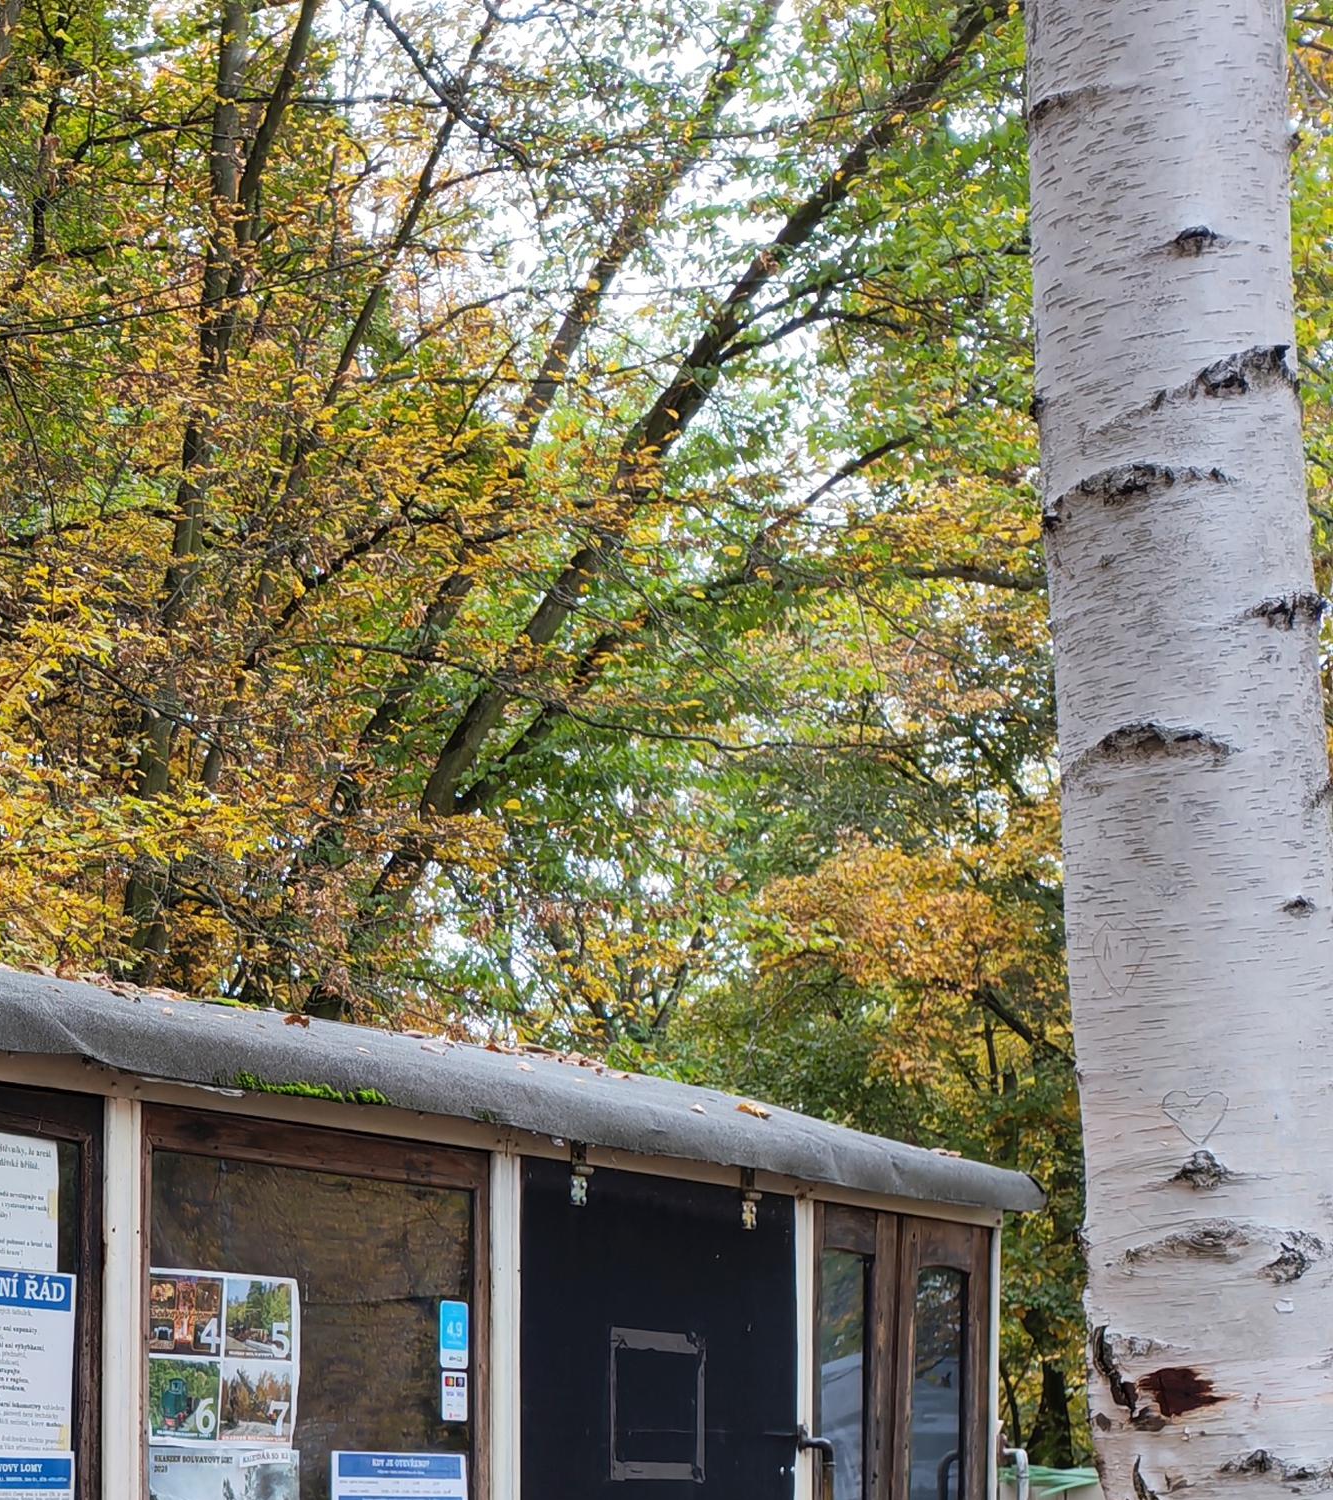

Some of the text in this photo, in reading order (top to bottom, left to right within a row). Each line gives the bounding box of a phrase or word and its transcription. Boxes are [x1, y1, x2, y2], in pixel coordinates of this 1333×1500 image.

[24, 1274, 66, 1302] ŘÁD
[201, 1318, 291, 1358] 4 5
[196, 1398, 289, 1436] 6 7
[20, 1464, 43, 1473] LOMY
